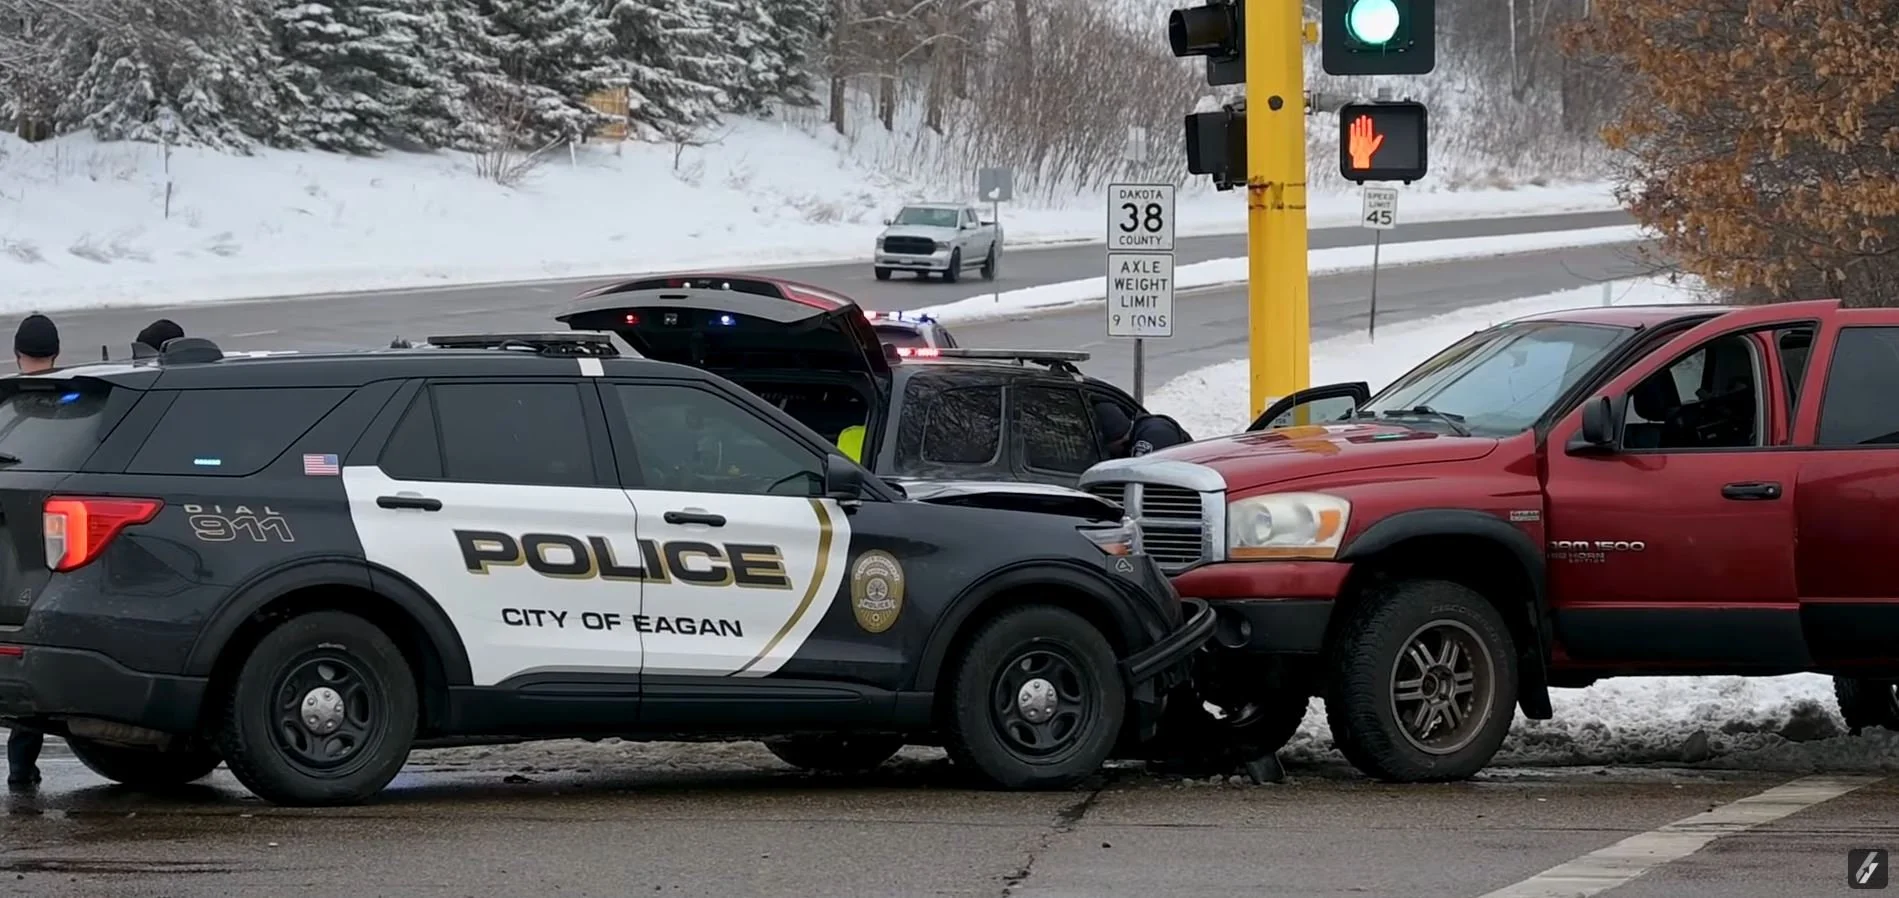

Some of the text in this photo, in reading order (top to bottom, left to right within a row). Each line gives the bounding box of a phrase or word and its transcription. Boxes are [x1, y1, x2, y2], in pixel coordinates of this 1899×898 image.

[1119, 190, 1164, 199] DAKOTA
[1119, 203, 1164, 233] 38
[1366, 210, 1392, 225] 45
[1119, 236, 1163, 245] COUNTY
[1121, 261, 1161, 274] AXLE
[1114, 278, 1168, 291] WEIGHT
[1121, 296, 1159, 308] LIMIT
[1113, 314, 1121, 327] 9
[183, 504, 280, 515] DIAL
[189, 514, 295, 542] 911
[1594, 541, 1645, 551] 1500
[452, 528, 794, 590] POLICE
[863, 600, 890, 609] POLICE
[501, 607, 744, 637] CITY OF EAGAN
